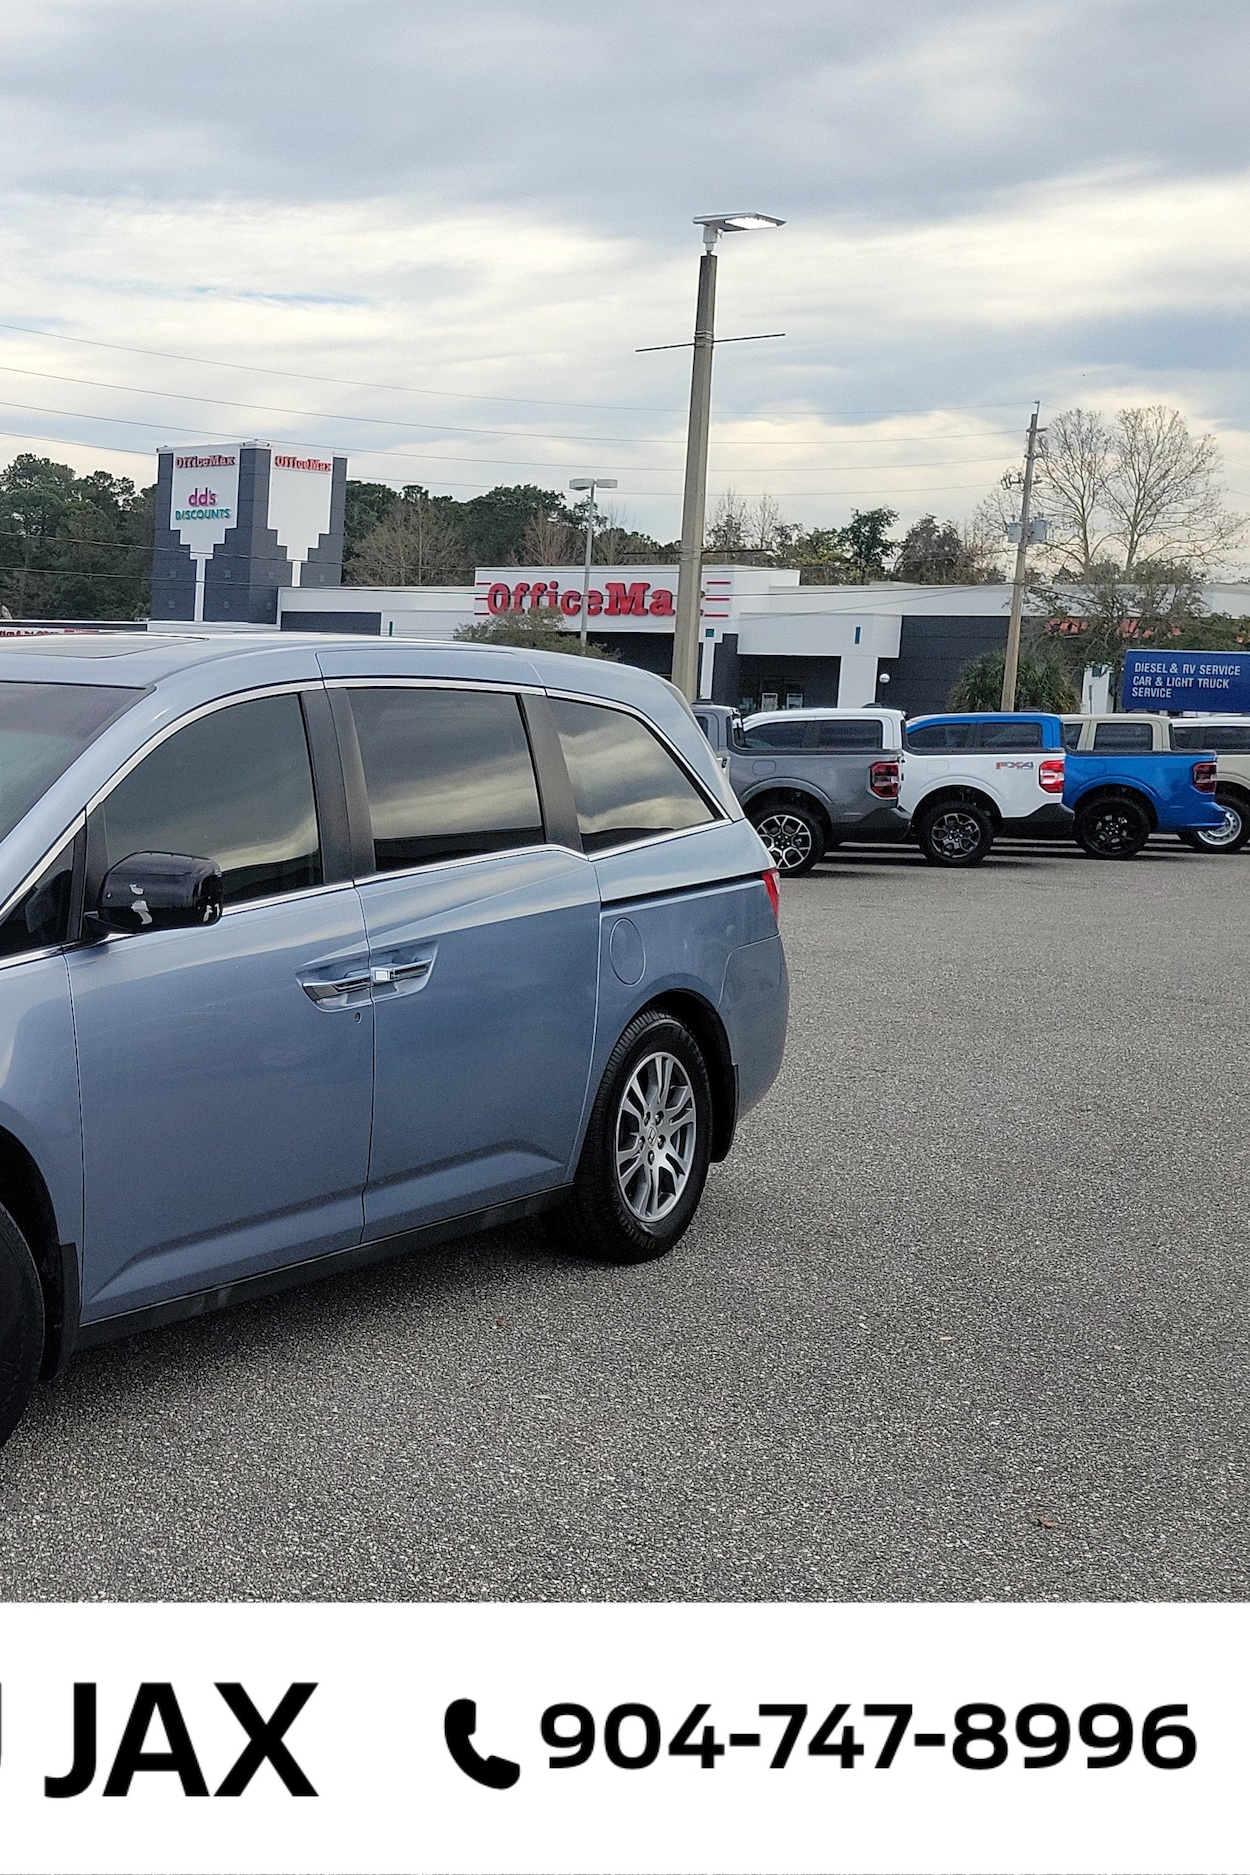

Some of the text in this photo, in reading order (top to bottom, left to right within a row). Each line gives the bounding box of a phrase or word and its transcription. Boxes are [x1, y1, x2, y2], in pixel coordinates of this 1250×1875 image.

[175, 455, 235, 469] OfficeMax
[275, 455, 332, 472] OfficeMax
[188, 487, 218, 507] dd's
[175, 508, 231, 521] DISCOUNTS
[487, 580, 704, 617] OfficeMa
[1134, 662, 1241, 676] DIESEL & RV SERVICE
[1132, 675, 1230, 689] CAR & LIGHT TRUCK
[1132, 687, 1172, 699] SERVICE
